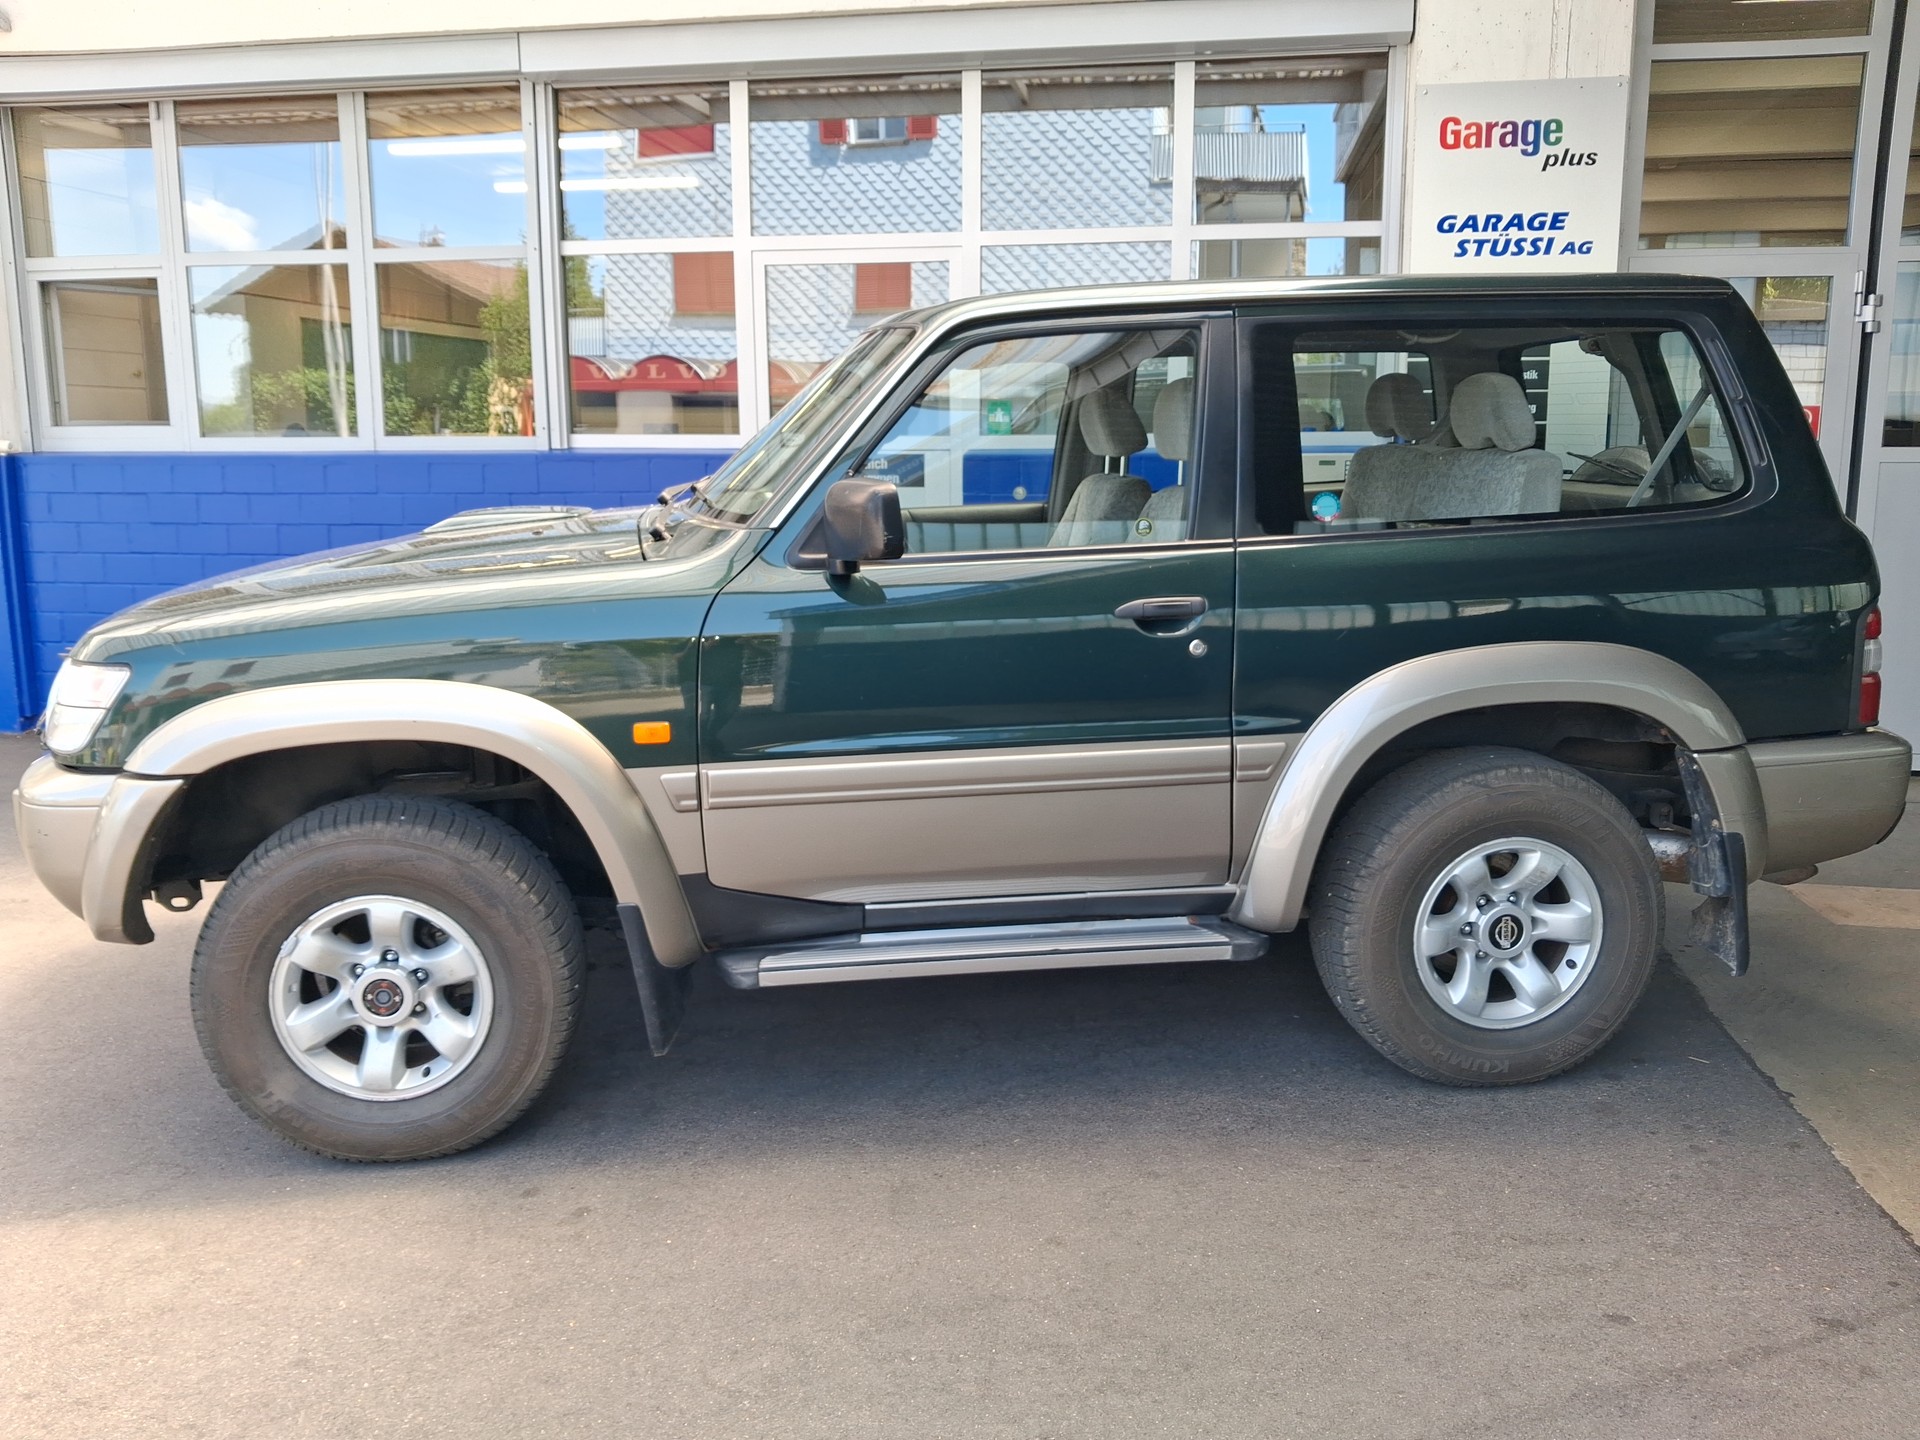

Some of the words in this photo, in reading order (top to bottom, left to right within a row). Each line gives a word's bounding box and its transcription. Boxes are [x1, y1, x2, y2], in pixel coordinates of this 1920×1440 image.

[1439, 116, 1564, 157] Garage
[1541, 148, 1598, 172] plus
[1436, 211, 1570, 234] GARAGE
[1454, 233, 1556, 258] STÜSSI
[1558, 240, 1593, 256] AG
